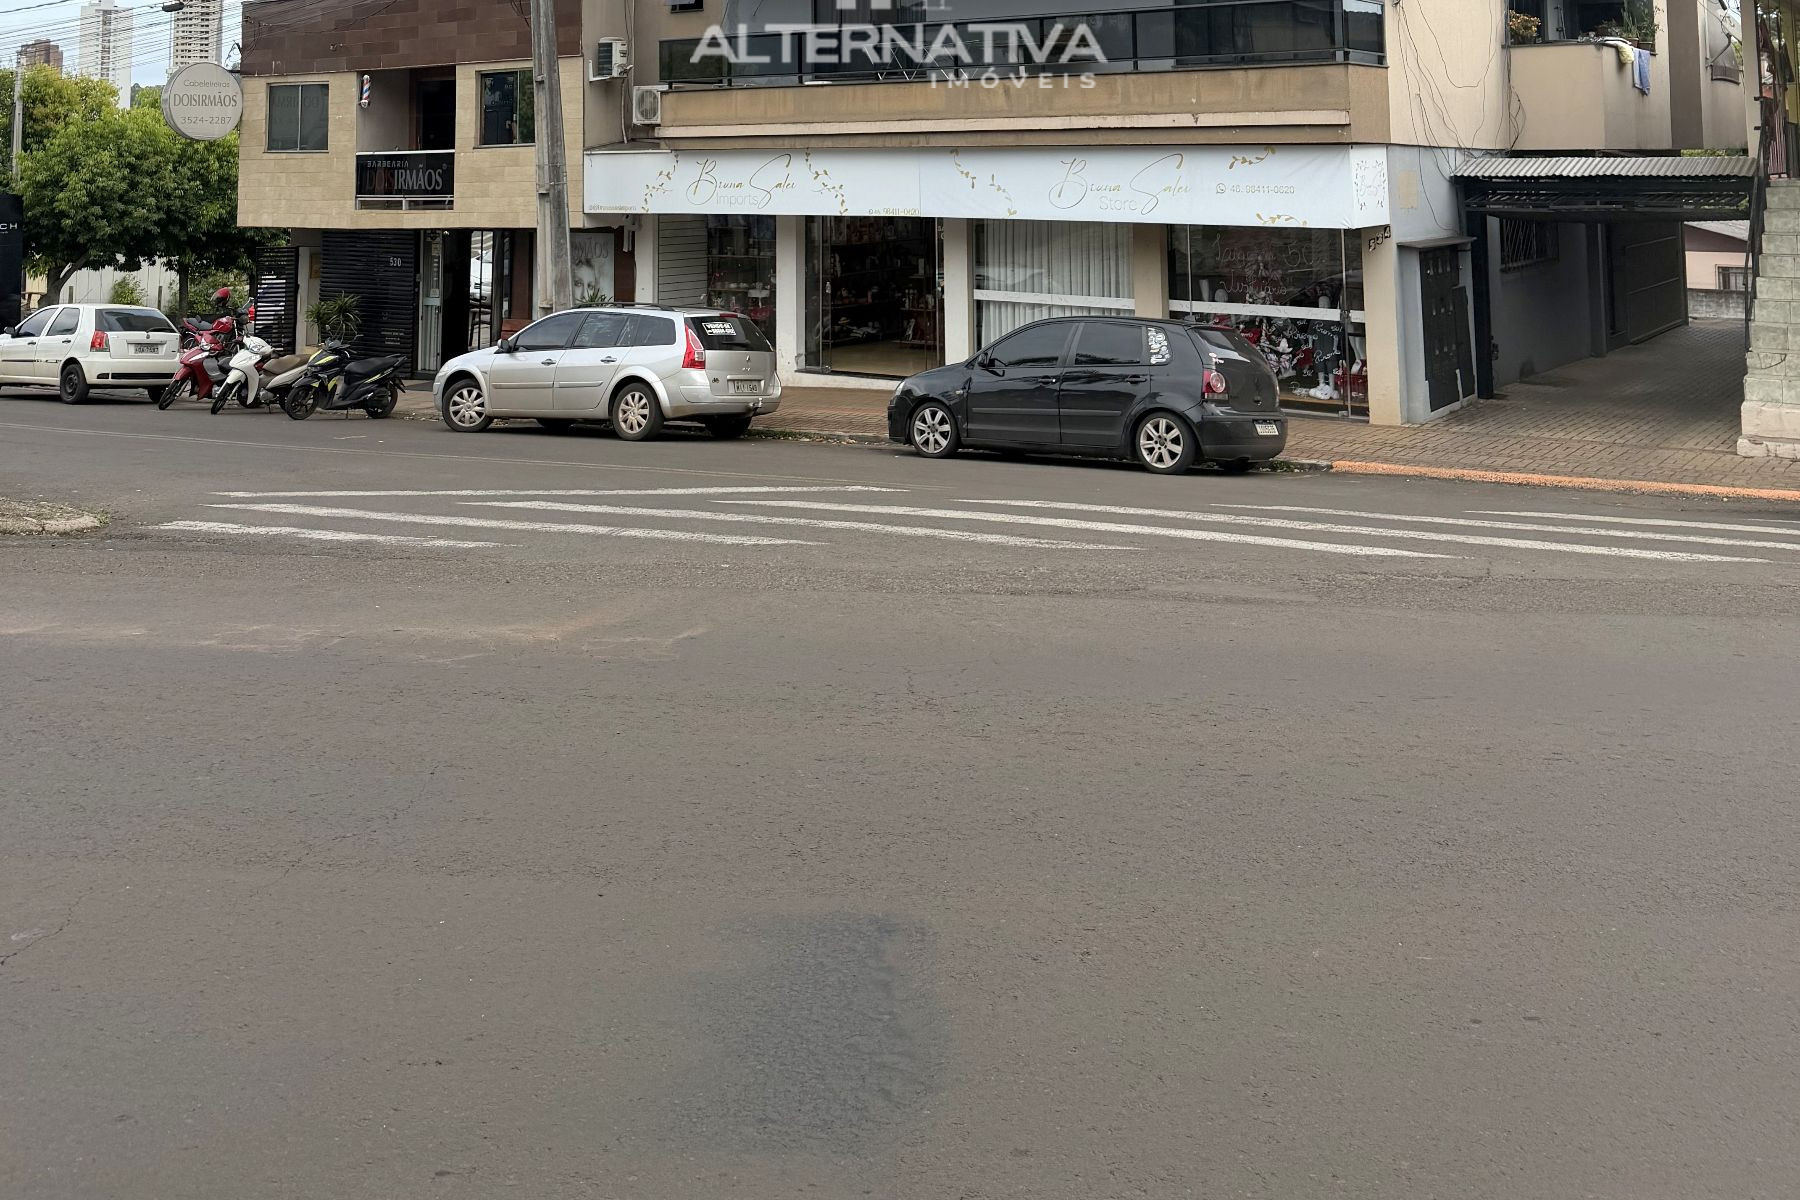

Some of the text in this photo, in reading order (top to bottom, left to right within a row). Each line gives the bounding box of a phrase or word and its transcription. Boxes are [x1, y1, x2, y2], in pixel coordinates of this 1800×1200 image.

[173, 91, 238, 107] DOISIRMÃOS
[181, 116, 232, 125] 3524-2287
[686, 158, 743, 205] Bruna
[1049, 158, 1121, 209] Bruna
[716, 192, 759, 206] Imports
[1099, 195, 1138, 211] Store
[389, 256, 402, 267] 530
